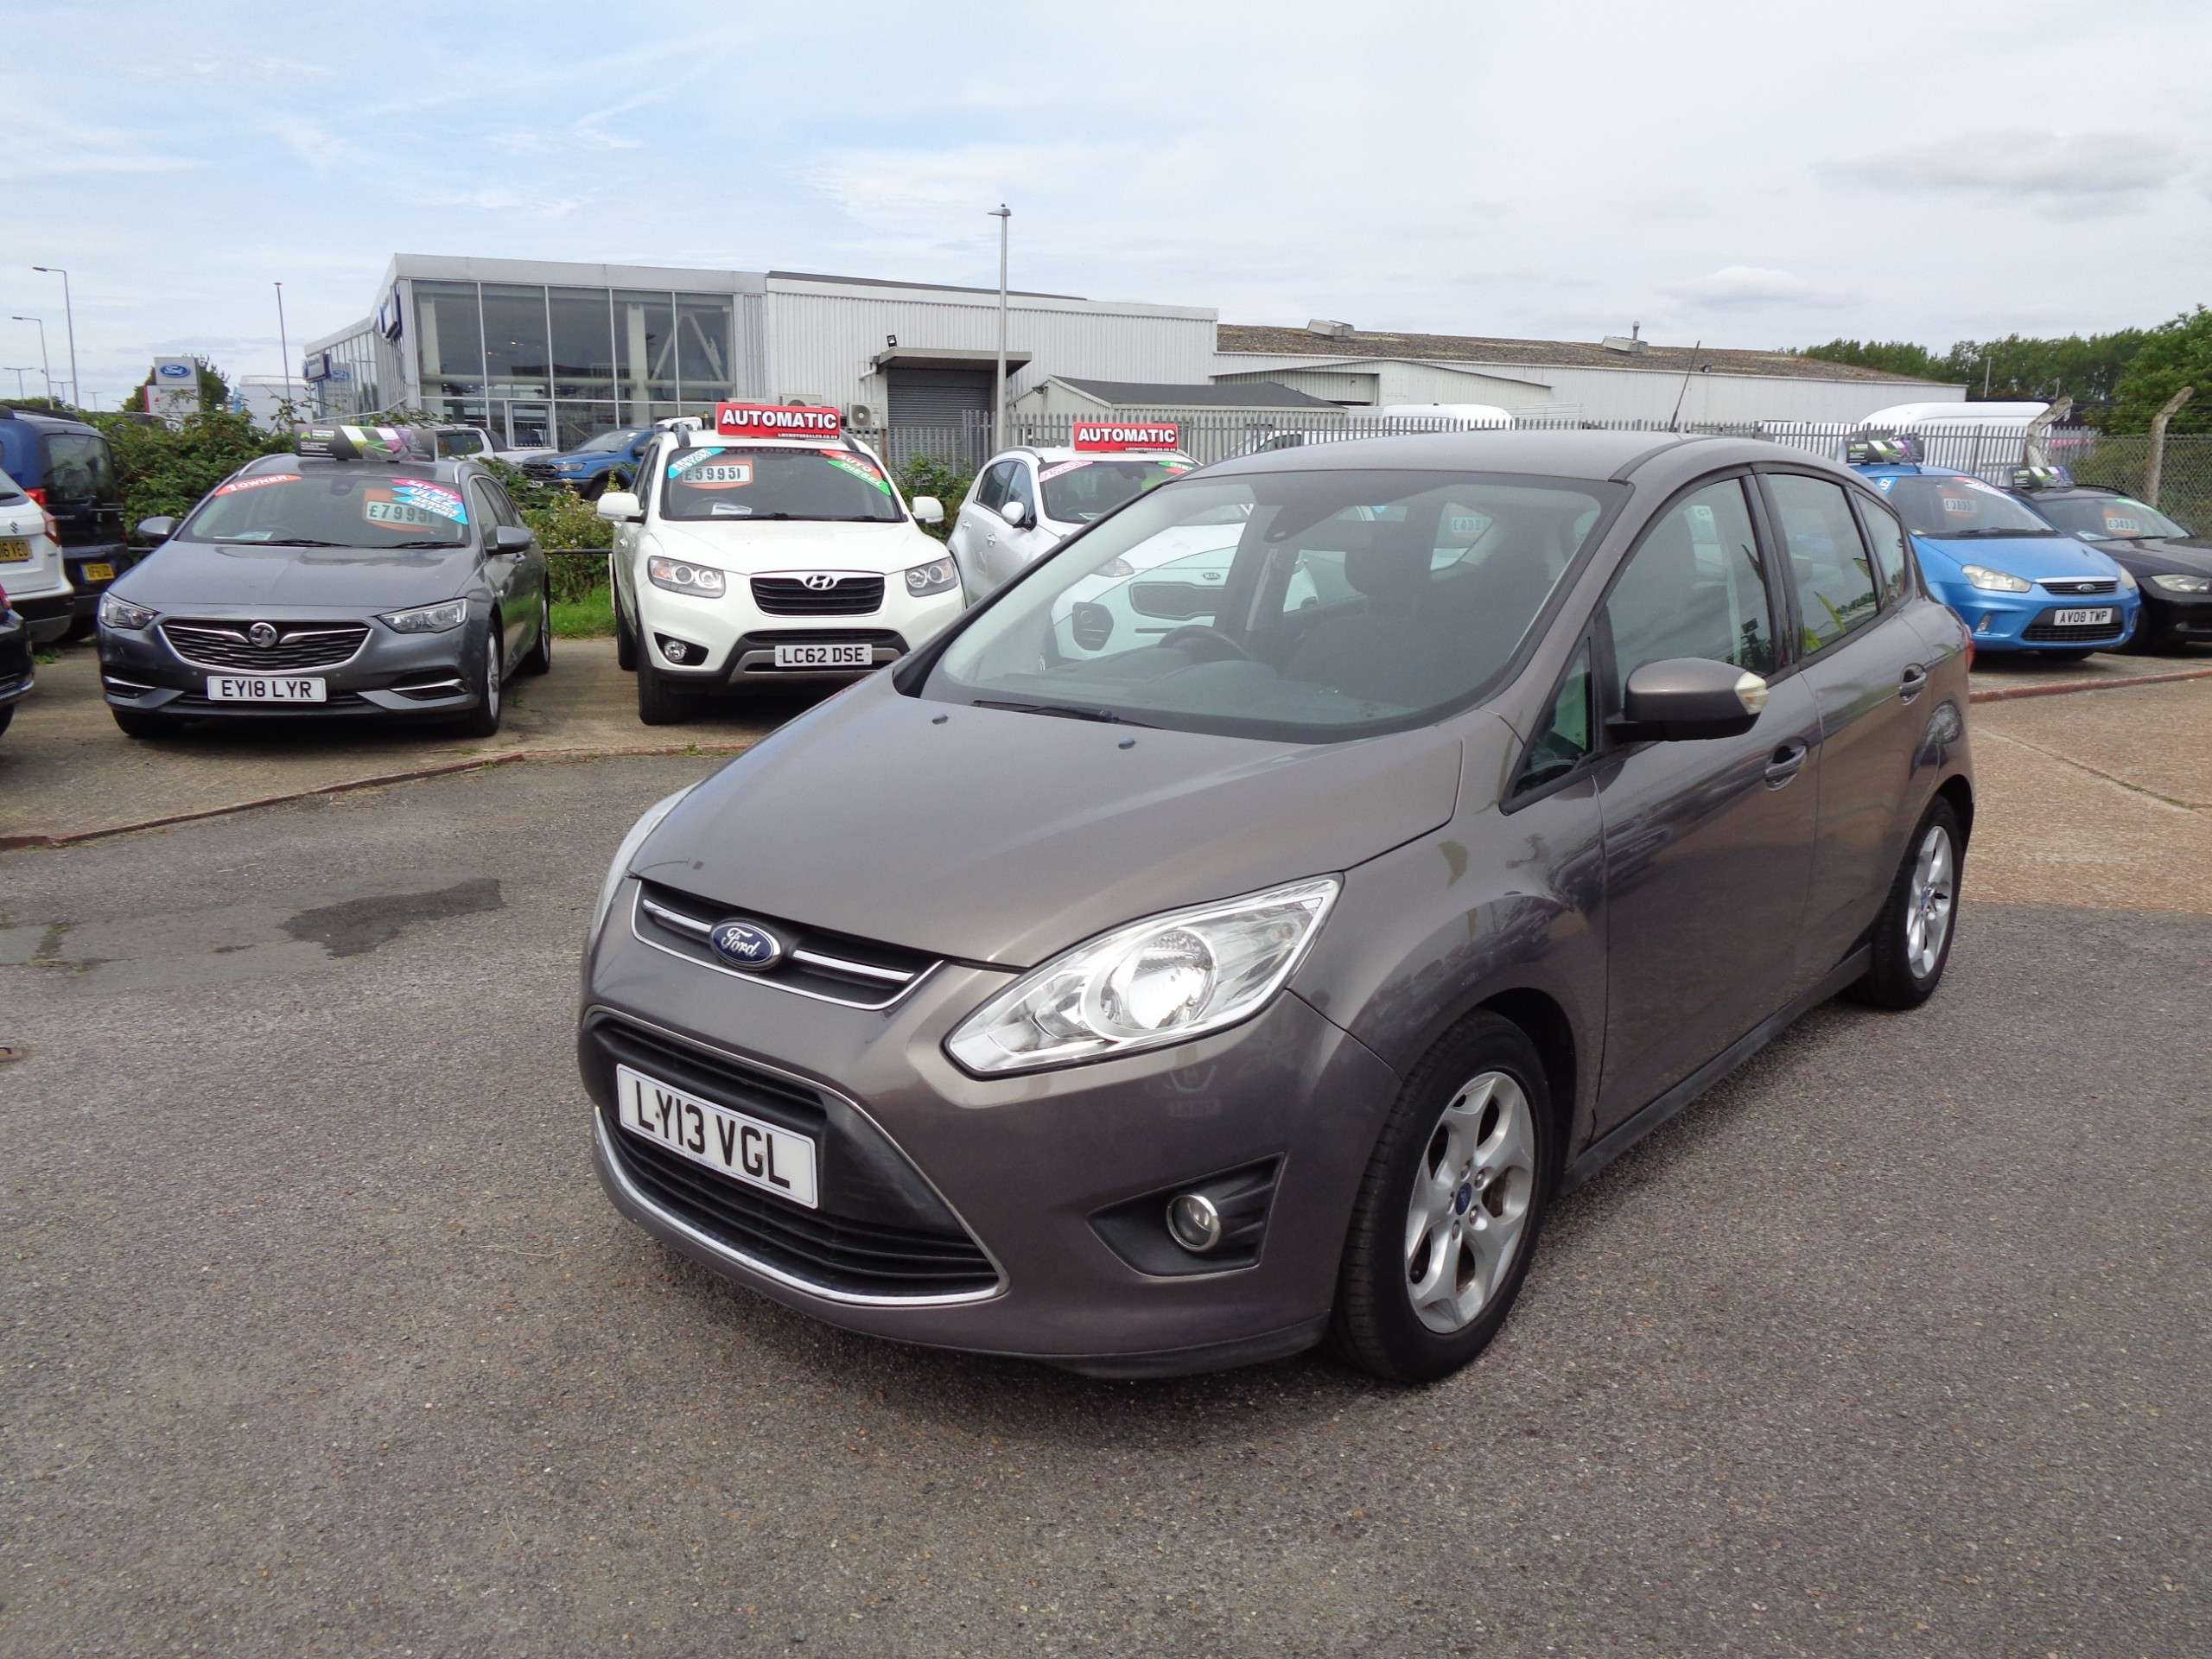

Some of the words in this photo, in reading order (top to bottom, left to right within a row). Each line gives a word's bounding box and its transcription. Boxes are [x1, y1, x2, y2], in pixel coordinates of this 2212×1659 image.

[721, 409, 838, 429] AUTOMATIC
[1077, 428, 1176, 443] AUTOMATIC
[836, 454, 873, 473] AUTO
[238, 474, 289, 489] OWNER
[841, 462, 883, 486] DIESEL
[409, 488, 461, 506] ULEZ
[2059, 611, 2087, 623] AV08
[2089, 610, 2107, 622] TWP
[782, 648, 827, 664] LC62
[832, 647, 865, 663] DSE
[221, 679, 265, 697] EY18
[272, 680, 312, 698] LYR
[721, 927, 761, 957] Ford
[635, 1080, 706, 1155] LY13
[715, 1115, 791, 1190] VGL
